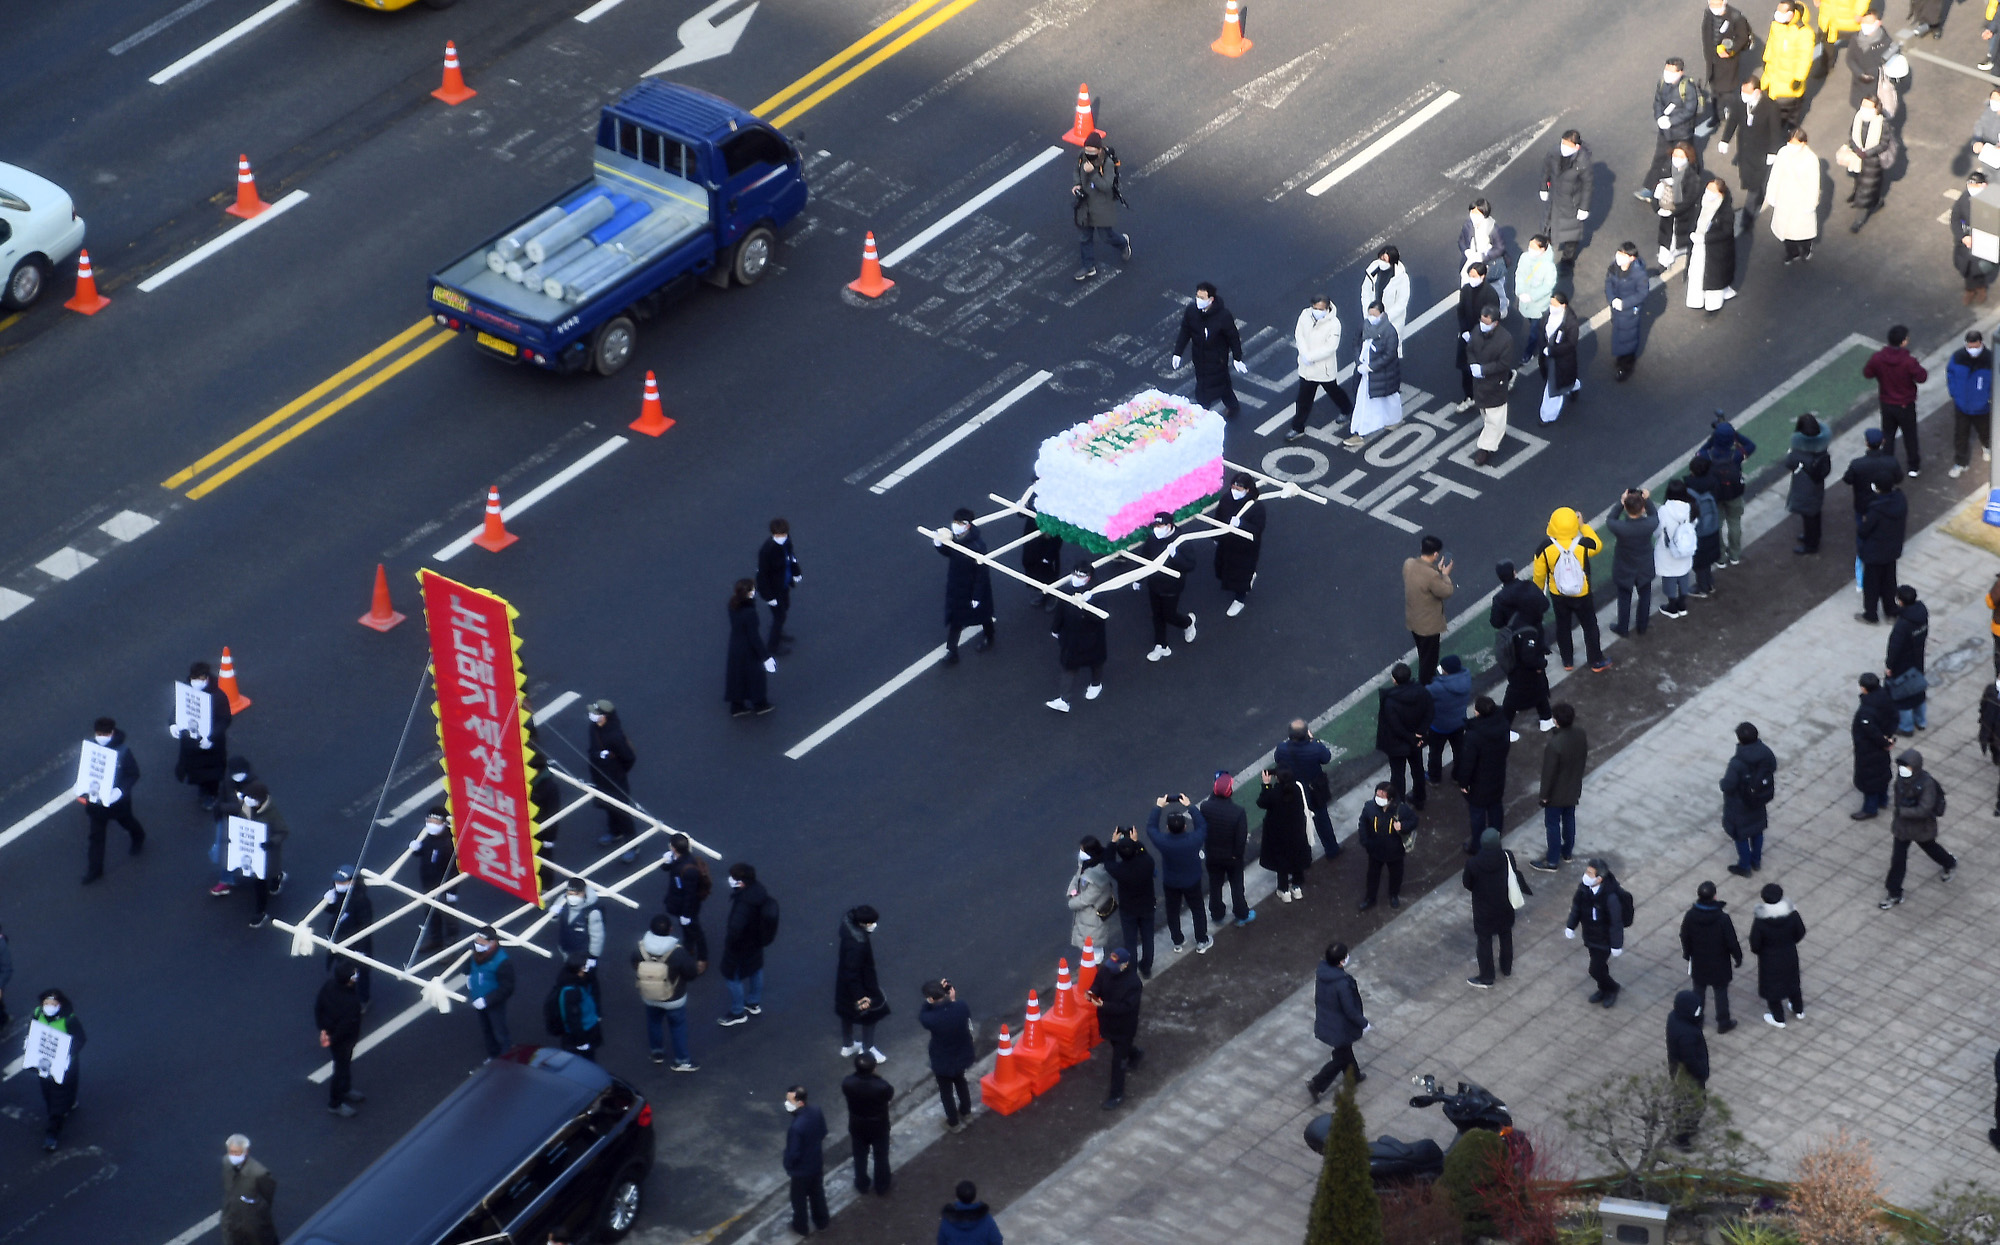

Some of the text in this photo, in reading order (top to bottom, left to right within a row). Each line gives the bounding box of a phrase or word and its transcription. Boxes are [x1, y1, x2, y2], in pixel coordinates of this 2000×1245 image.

[450, 594, 527, 890] 노나메기 세상 백기완
